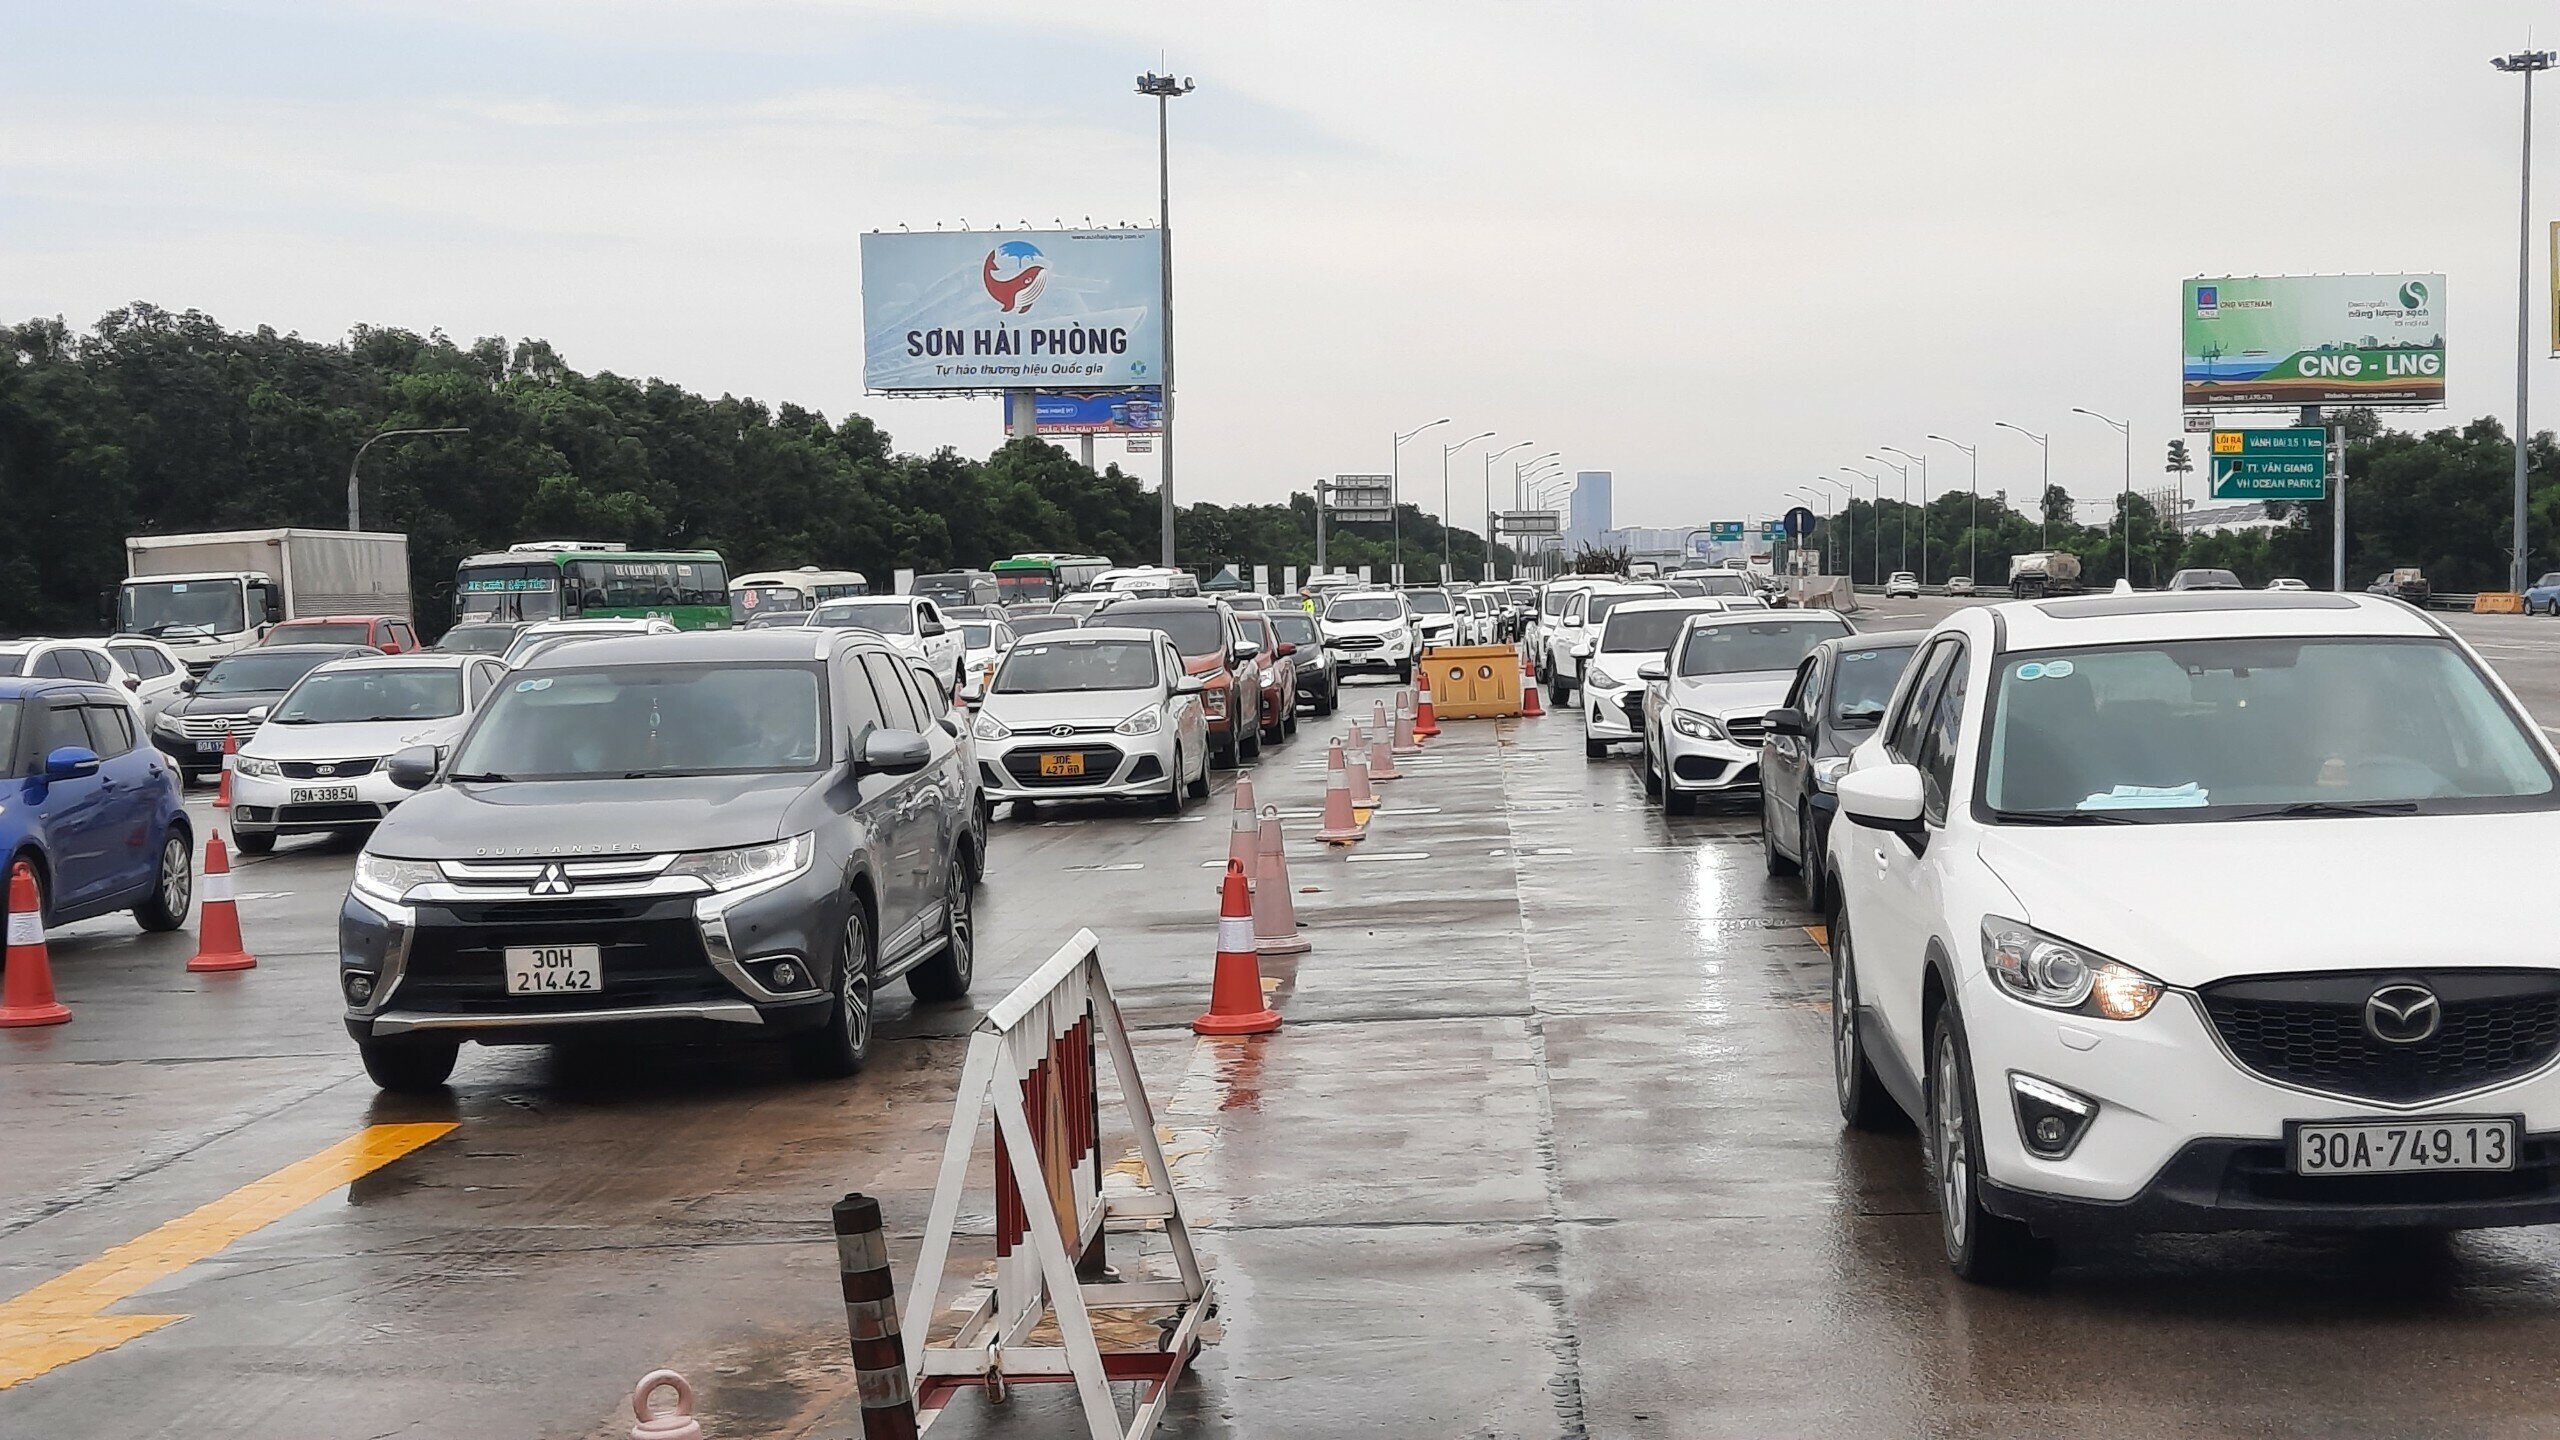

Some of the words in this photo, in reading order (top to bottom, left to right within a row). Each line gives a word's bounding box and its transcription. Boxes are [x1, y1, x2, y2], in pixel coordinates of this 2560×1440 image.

[2237, 300, 2273, 308] VIETNAM
[2405, 308, 2429, 318] sạch
[907, 327, 965, 357] SƠN
[973, 321, 1020, 356] HẢI
[1030, 321, 1128, 355] PHÒNG
[936, 365, 954, 377] Tự
[956, 364, 977, 375] hào
[980, 364, 1020, 377] thương
[1022, 363, 1048, 375] hiệu
[1051, 360, 1082, 375] Quốc
[1085, 363, 1103, 376] gia
[2298, 354, 2362, 377] CNG
[2386, 353, 2440, 375] LNG
[2216, 434, 2229, 444] LỐI
[2230, 435, 2242, 444] RA
[2249, 435, 2271, 447] VÀNH
[2308, 438, 2322, 447] km
[2261, 462, 2282, 473] VĂN
[2283, 463, 2314, 473] GIANG
[2236, 479, 2250, 488] VH
[2252, 479, 2285, 488] OCEAN
[2287, 479, 2313, 488] PARK
[2314, 479, 2321, 488] 2
[293, 787, 354, 803] 29A-338.54
[476, 843, 641, 856] OUTLANDER
[532, 949, 573, 969] 30H
[517, 970, 592, 991] 214.42
[2306, 1127, 2506, 1169] 30A-749.13
